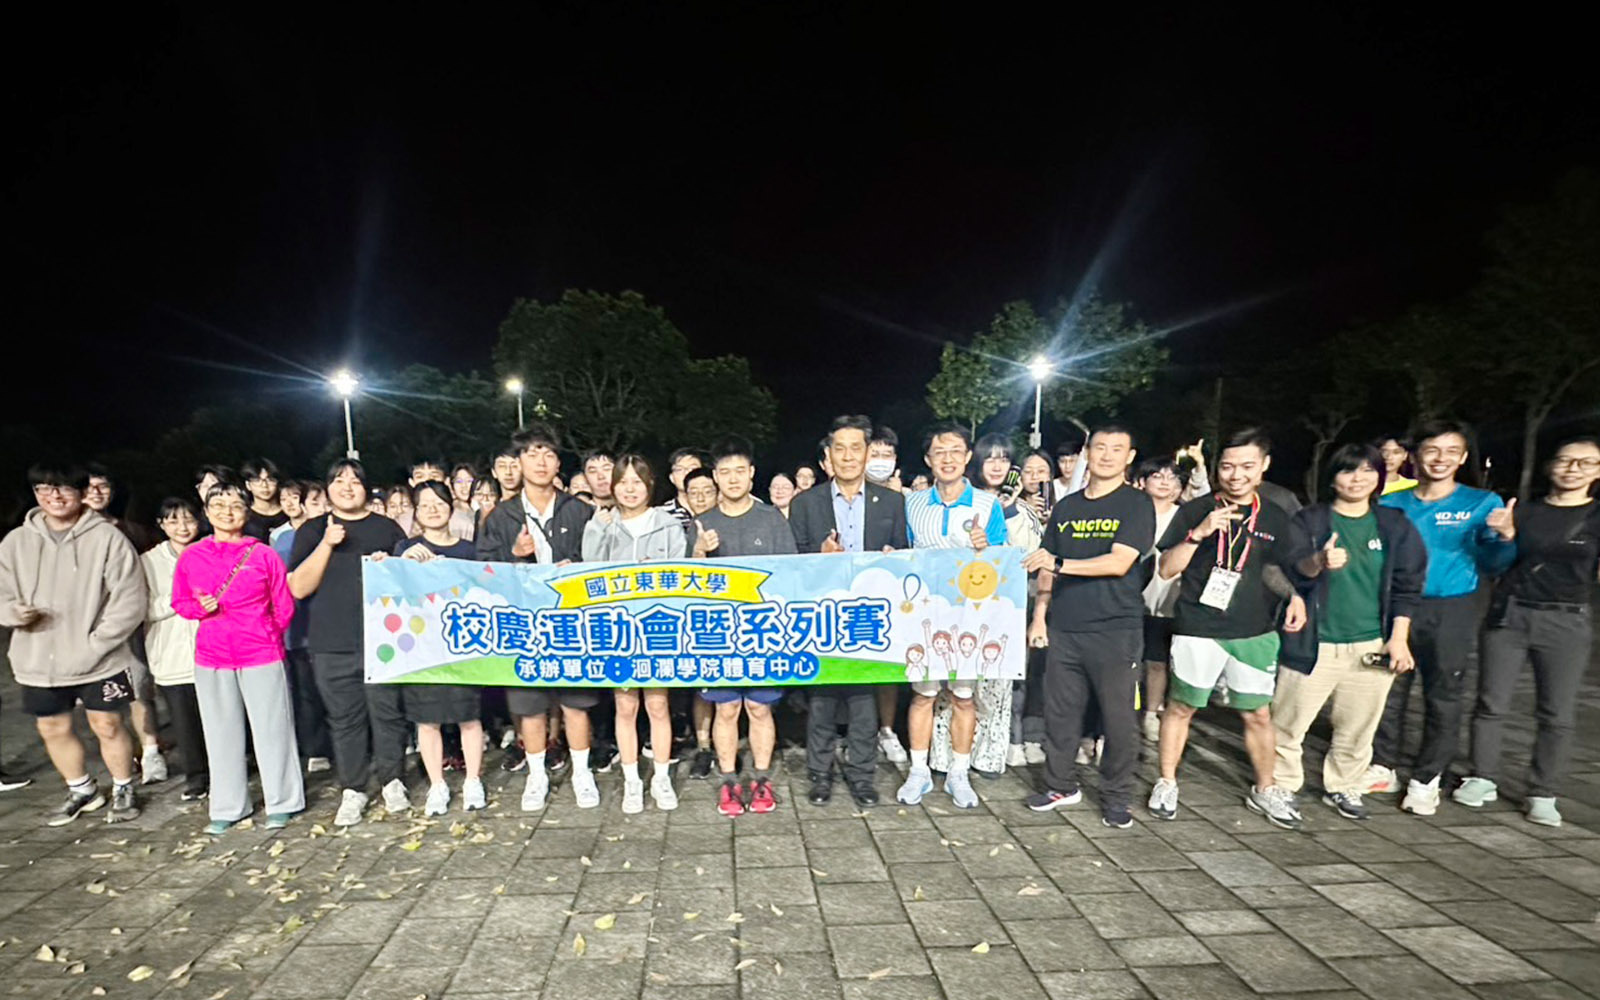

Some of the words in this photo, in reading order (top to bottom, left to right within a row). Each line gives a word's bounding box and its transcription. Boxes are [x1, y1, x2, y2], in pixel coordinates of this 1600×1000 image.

[584, 570, 727, 598] 國立東華大學
[445, 602, 887, 653] 校慶運動會暨系列賽
